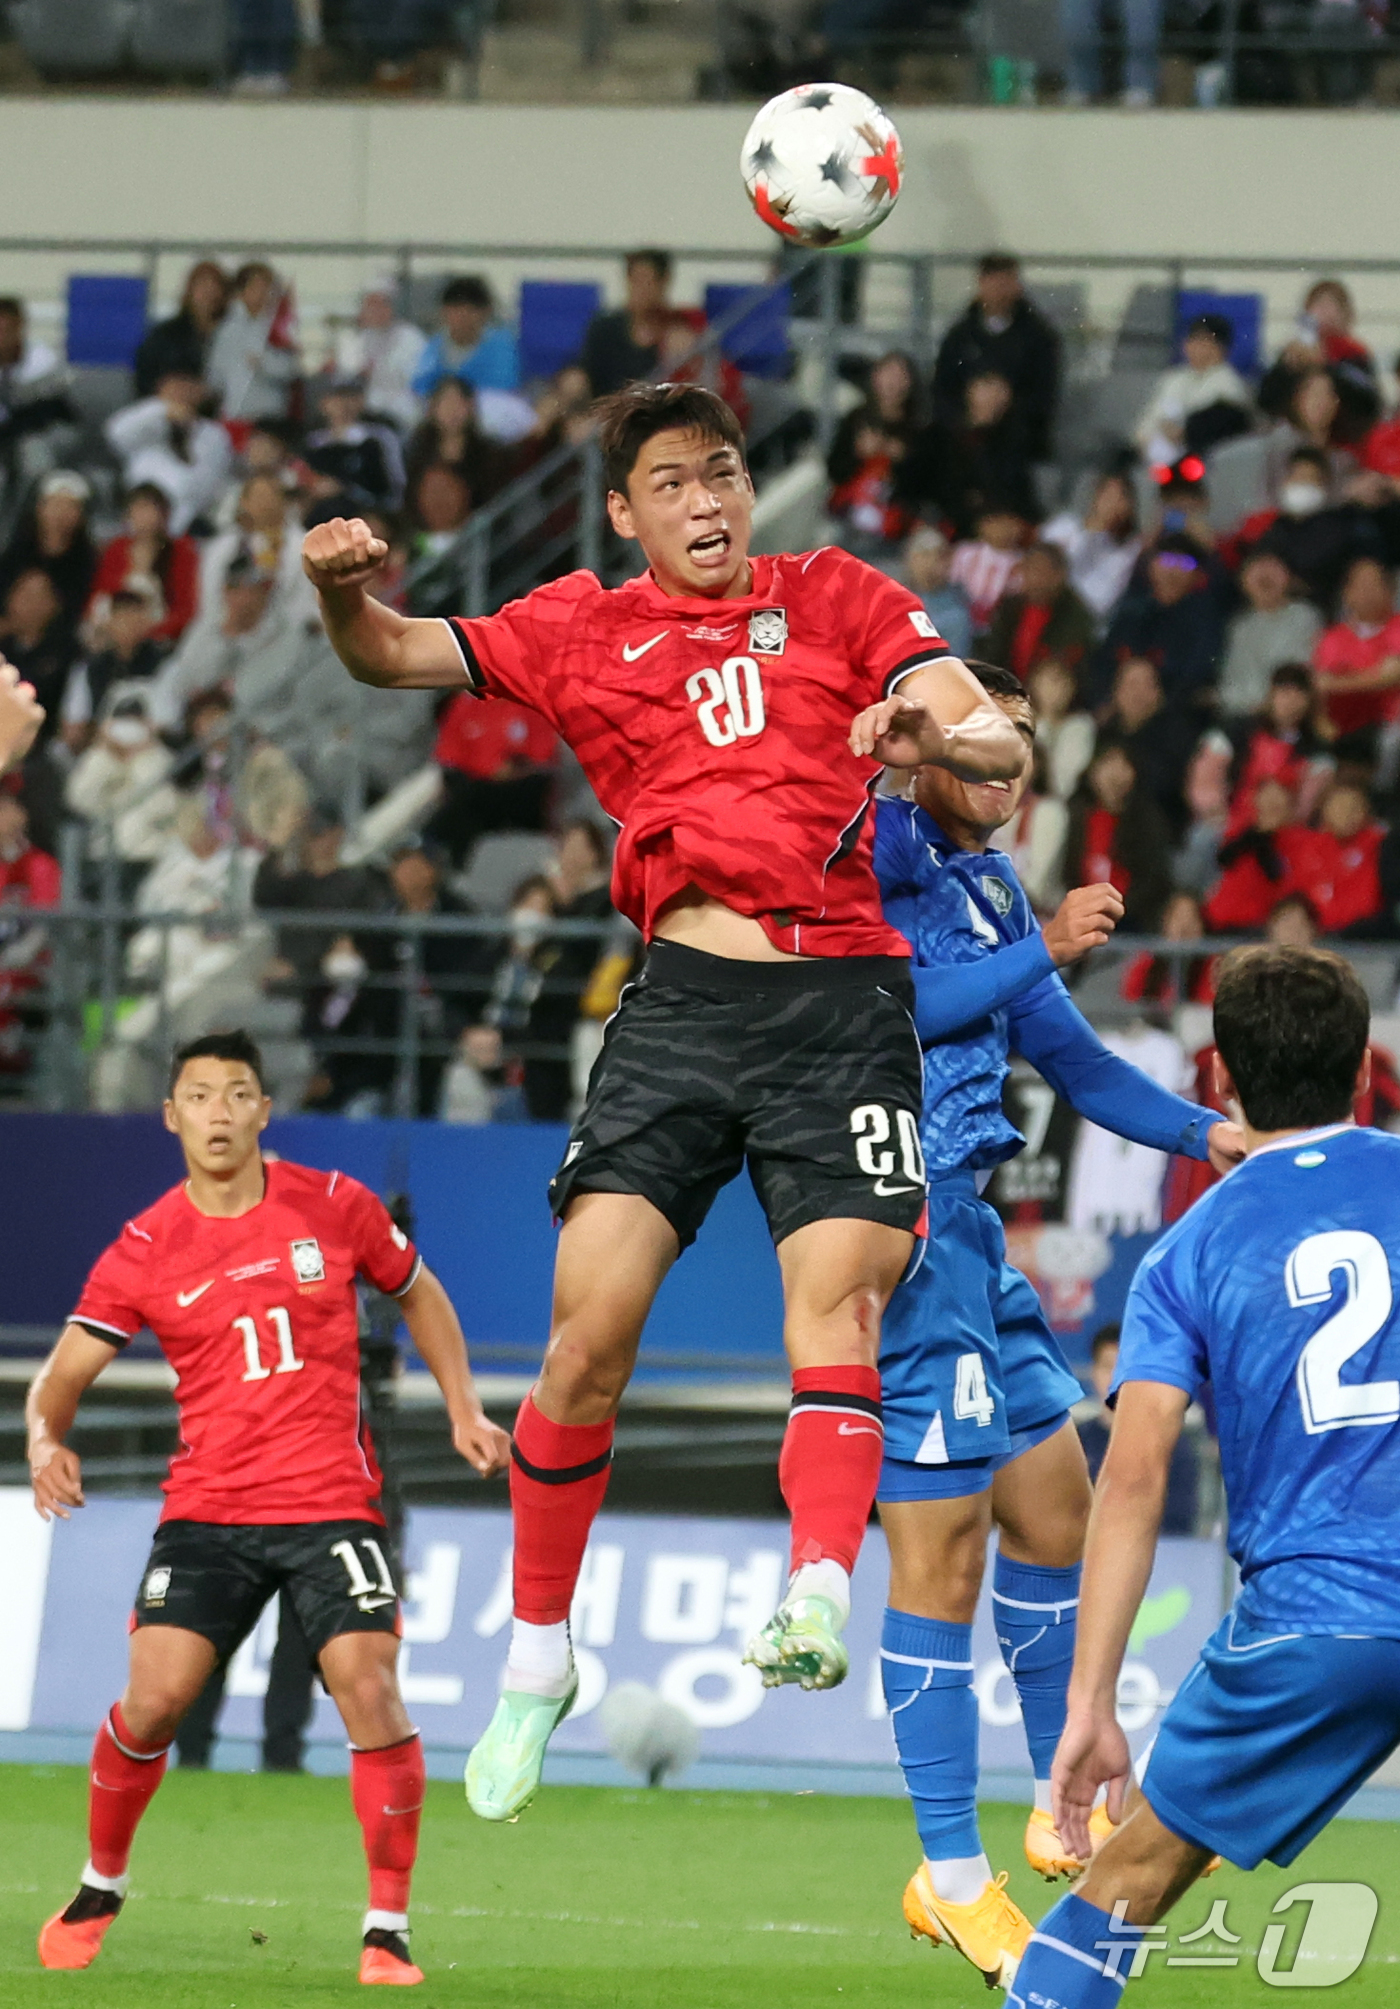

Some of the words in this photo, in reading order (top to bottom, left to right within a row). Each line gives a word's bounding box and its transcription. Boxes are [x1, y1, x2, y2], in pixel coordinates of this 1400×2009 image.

[685, 656, 766, 747] 20
[850, 1103, 926, 1186] 20
[232, 1306, 305, 1382] 11
[1284, 1229, 1400, 1435] 2
[953, 1352, 995, 1427] 4
[330, 1538, 396, 1597] 11
